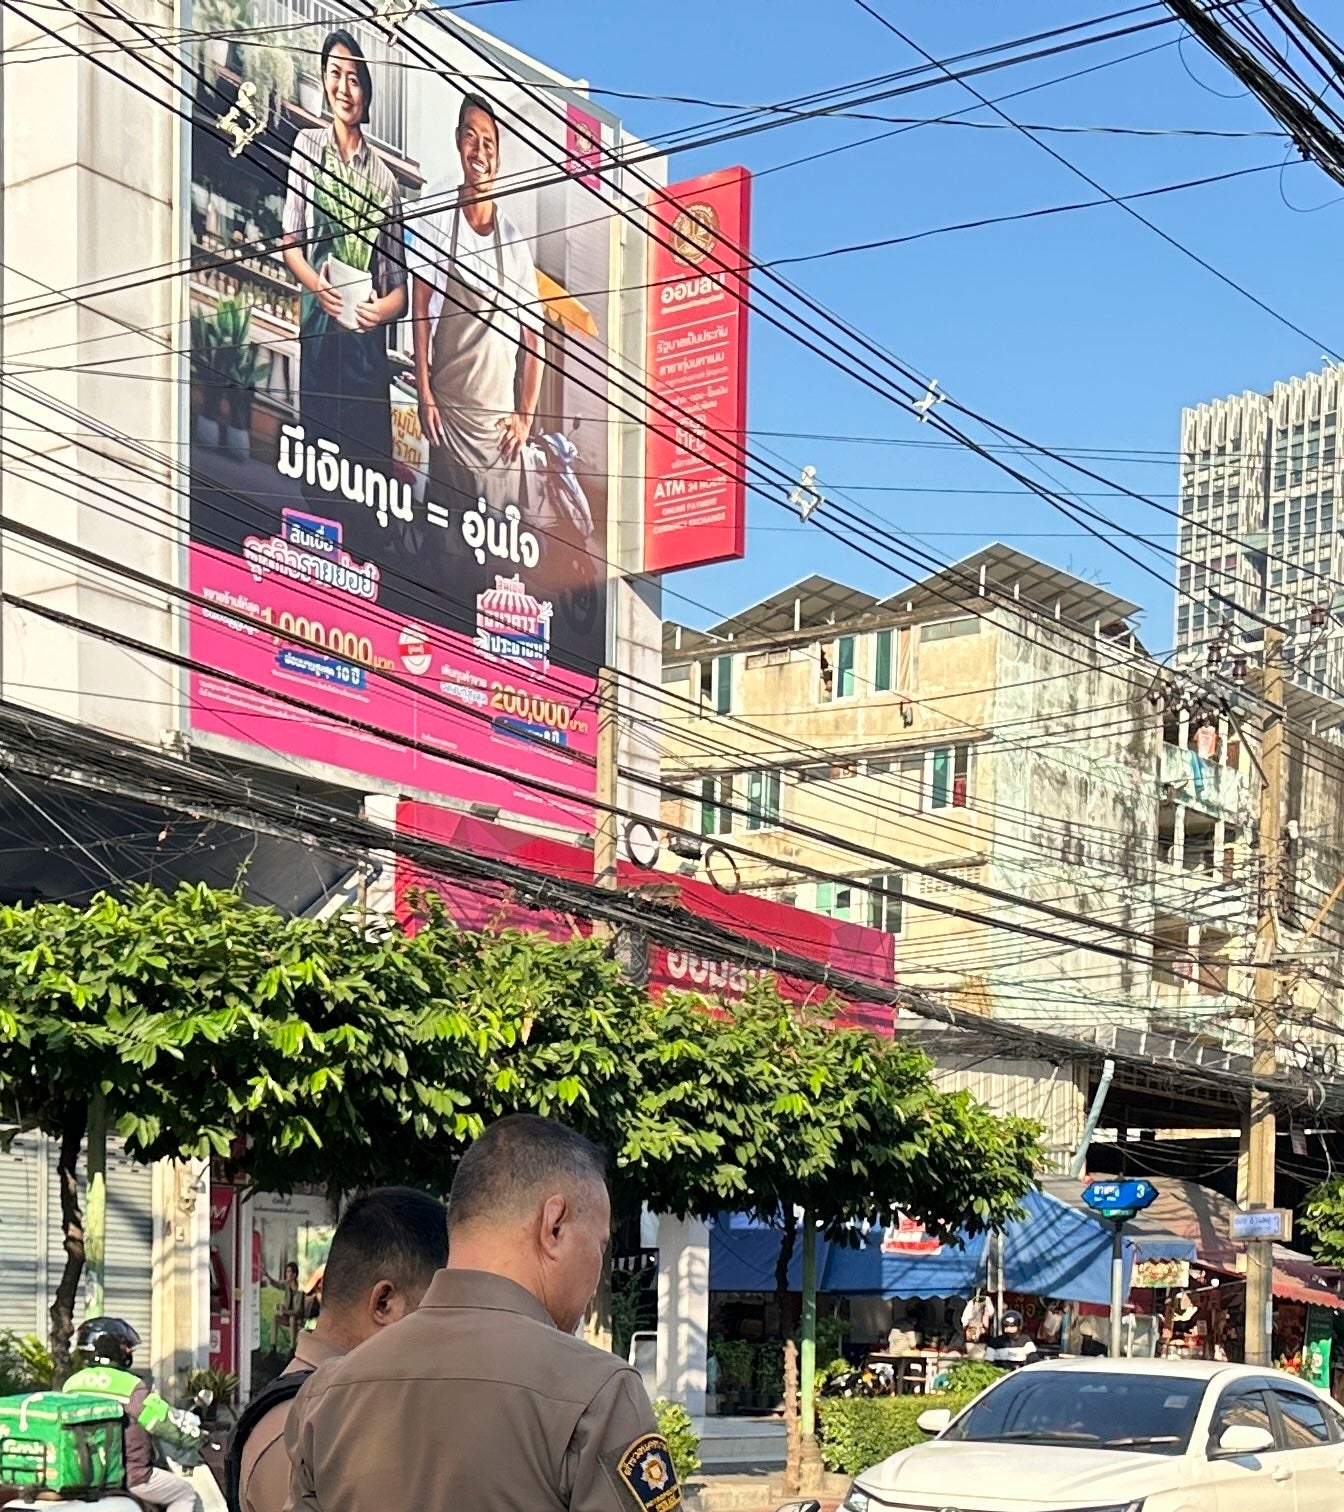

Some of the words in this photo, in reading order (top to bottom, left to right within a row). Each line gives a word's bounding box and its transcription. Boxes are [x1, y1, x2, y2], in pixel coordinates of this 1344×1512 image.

[277, 423, 413, 528] มีเงินทุน
[462, 497, 540, 568] อุ่นใจ
[654, 480, 686, 500] ATM
[336, 665, 350, 682] 10
[490, 681, 570, 730] 200,000
[1135, 1184, 1146, 1199] 3
